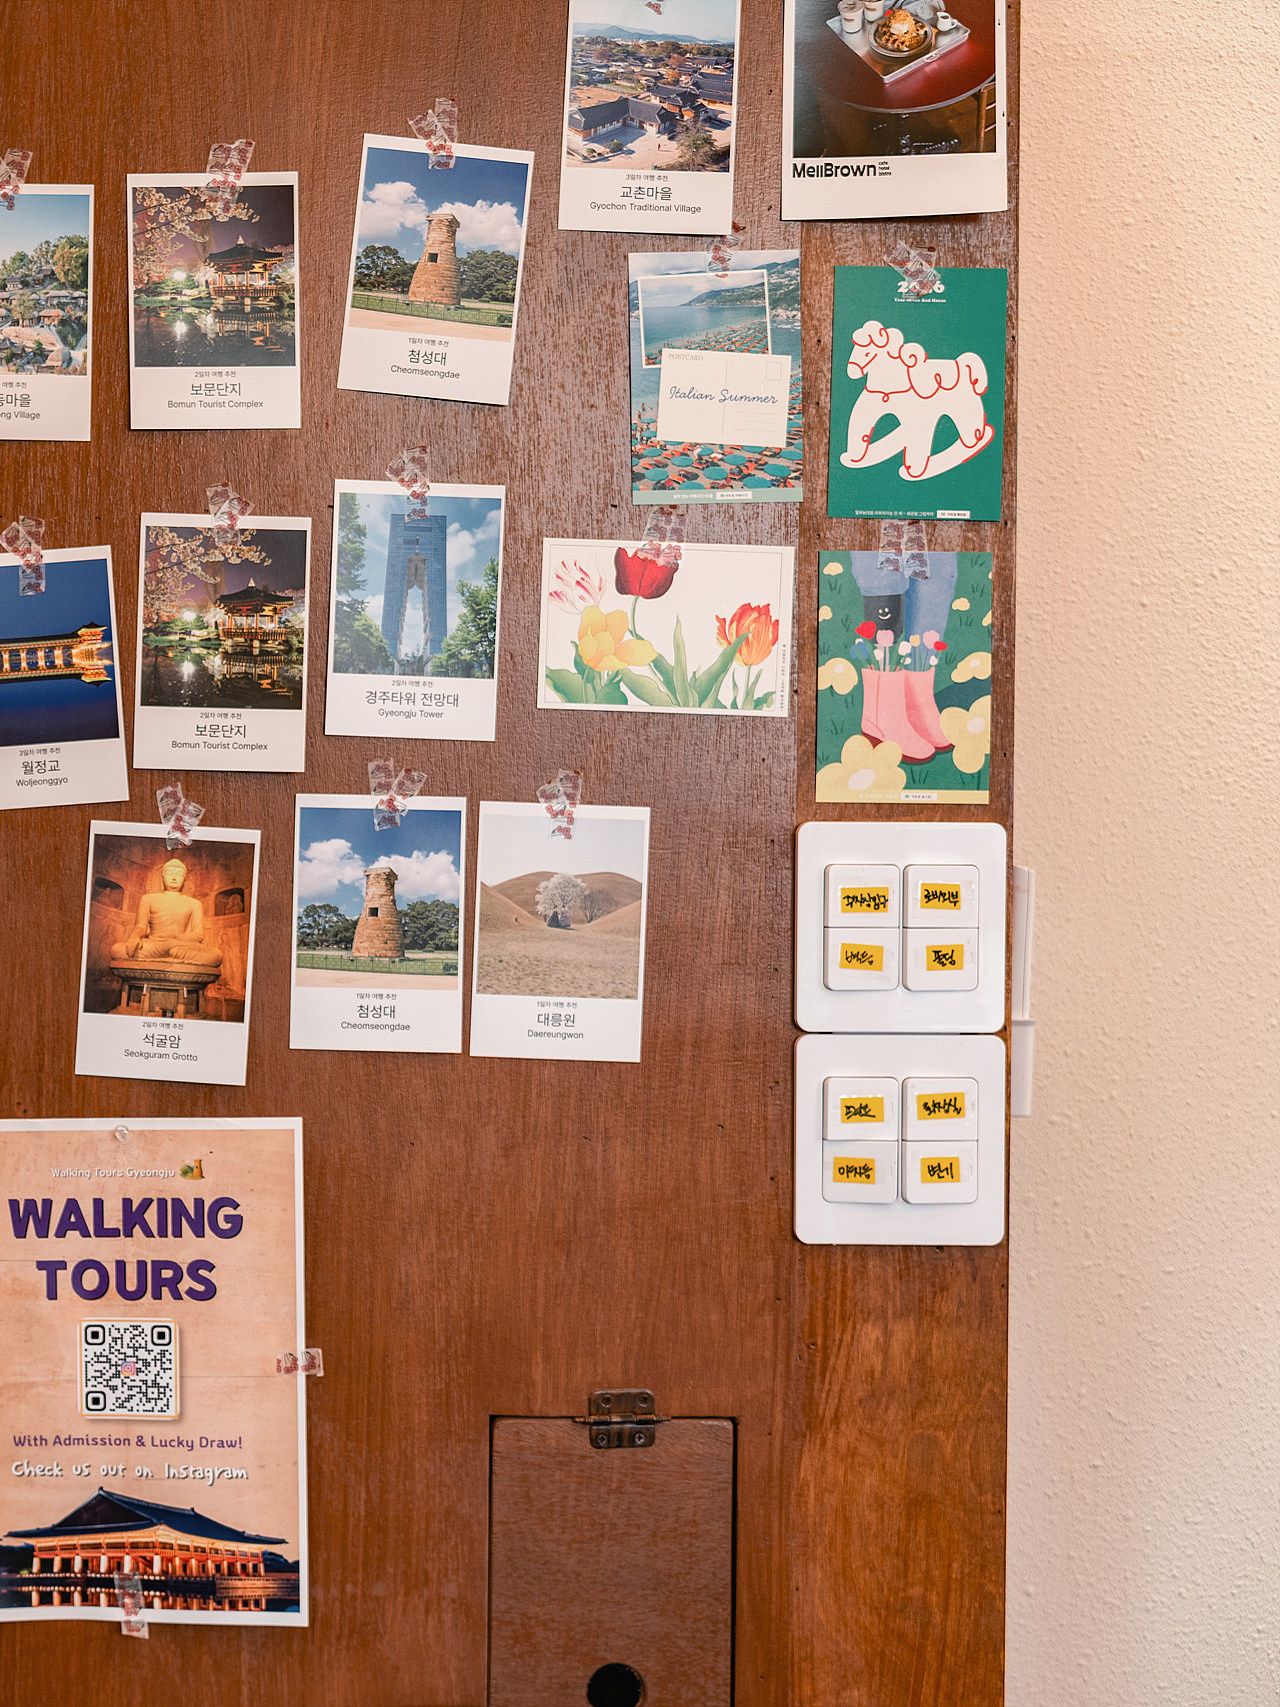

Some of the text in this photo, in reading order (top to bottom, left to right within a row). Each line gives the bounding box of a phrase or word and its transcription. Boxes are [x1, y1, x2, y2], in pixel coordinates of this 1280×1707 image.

[620, 186, 672, 200] 교촌마을
[590, 202, 701, 214] Gyochon Traditional Village
[408, 350, 447, 366] 첨성대
[391, 365, 460, 379] Cheomseongdae
[191, 382, 241, 396] 보문단지
[669, 386, 778, 404] Italian Summer
[13, 411, 40, 420] Village
[365, 691, 459, 708] 경주타워 전망대
[378, 708, 443, 718] Gyeongju Tower
[195, 725, 246, 738] 보문단지
[172, 741, 200, 749] Bomun
[232, 742, 268, 751] Complex
[22, 760, 60, 775] 월정교
[16, 777, 68, 787] Woljeonggyo
[357, 1004, 396, 1019] 첨성대
[341, 1022, 410, 1032] Cheomseongdae
[537, 1013, 576, 1027] 대릉원
[143, 1034, 181, 1048] 석굴암
[528, 1030, 583, 1040] Daereungwon
[124, 1050, 198, 1062] Seokguram Grotto
[52, 1167, 175, 1179] Walking Tours Gyeongju
[928, 1162, 953, 1179] 변기
[8, 1197, 243, 1239] WALKING
[36, 1259, 217, 1301] TOURS
[13, 1435, 242, 1451] With Admission & Lucky Draw!
[11, 1461, 249, 1487] Check us out on Instagram
